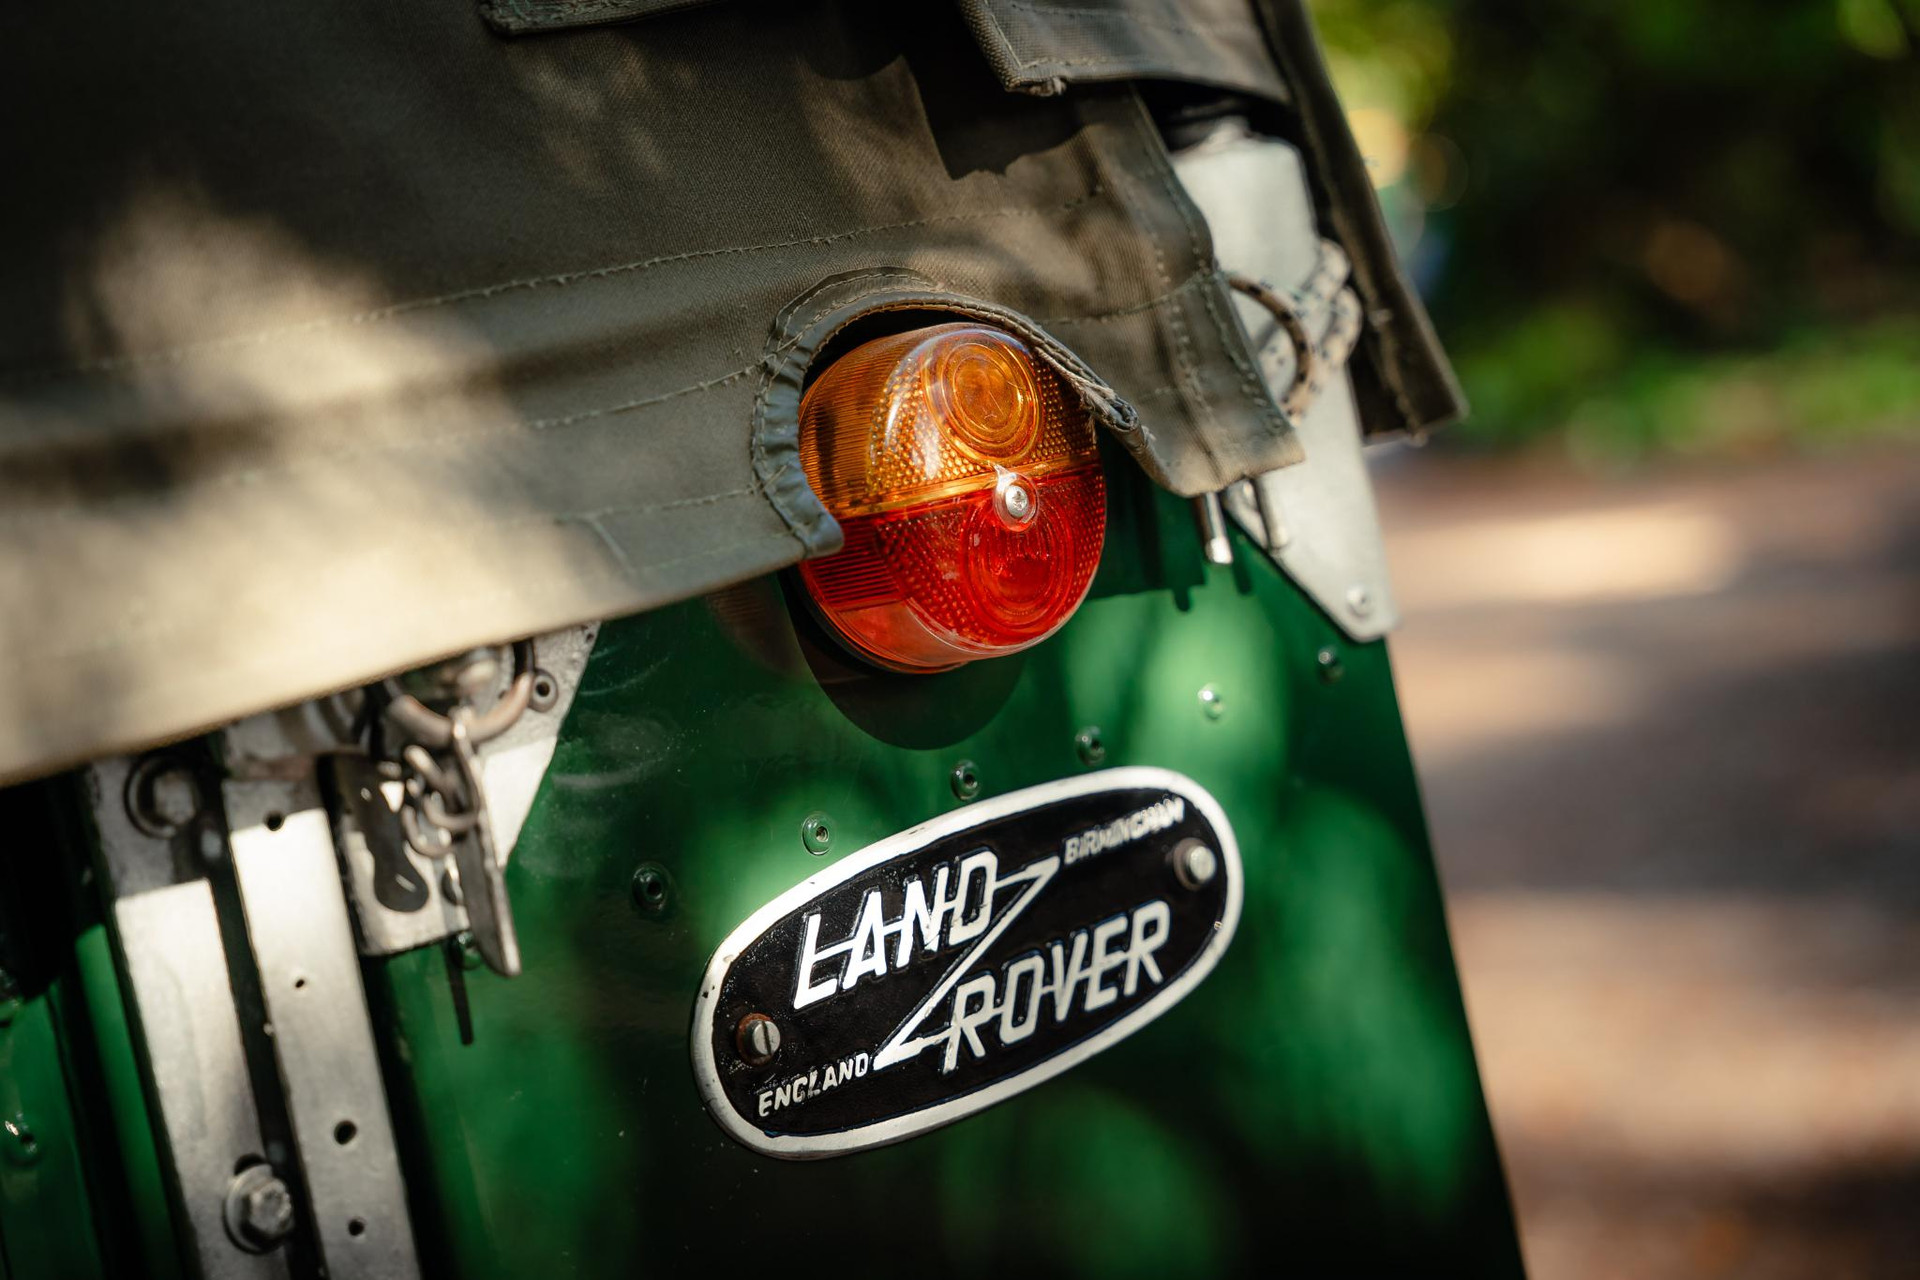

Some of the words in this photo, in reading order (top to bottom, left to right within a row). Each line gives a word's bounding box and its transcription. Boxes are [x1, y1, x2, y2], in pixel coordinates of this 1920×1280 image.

[793, 850, 999, 1010] LAND
[942, 901, 1170, 1074] ROVER
[758, 1052, 869, 1117] ENGLAND
